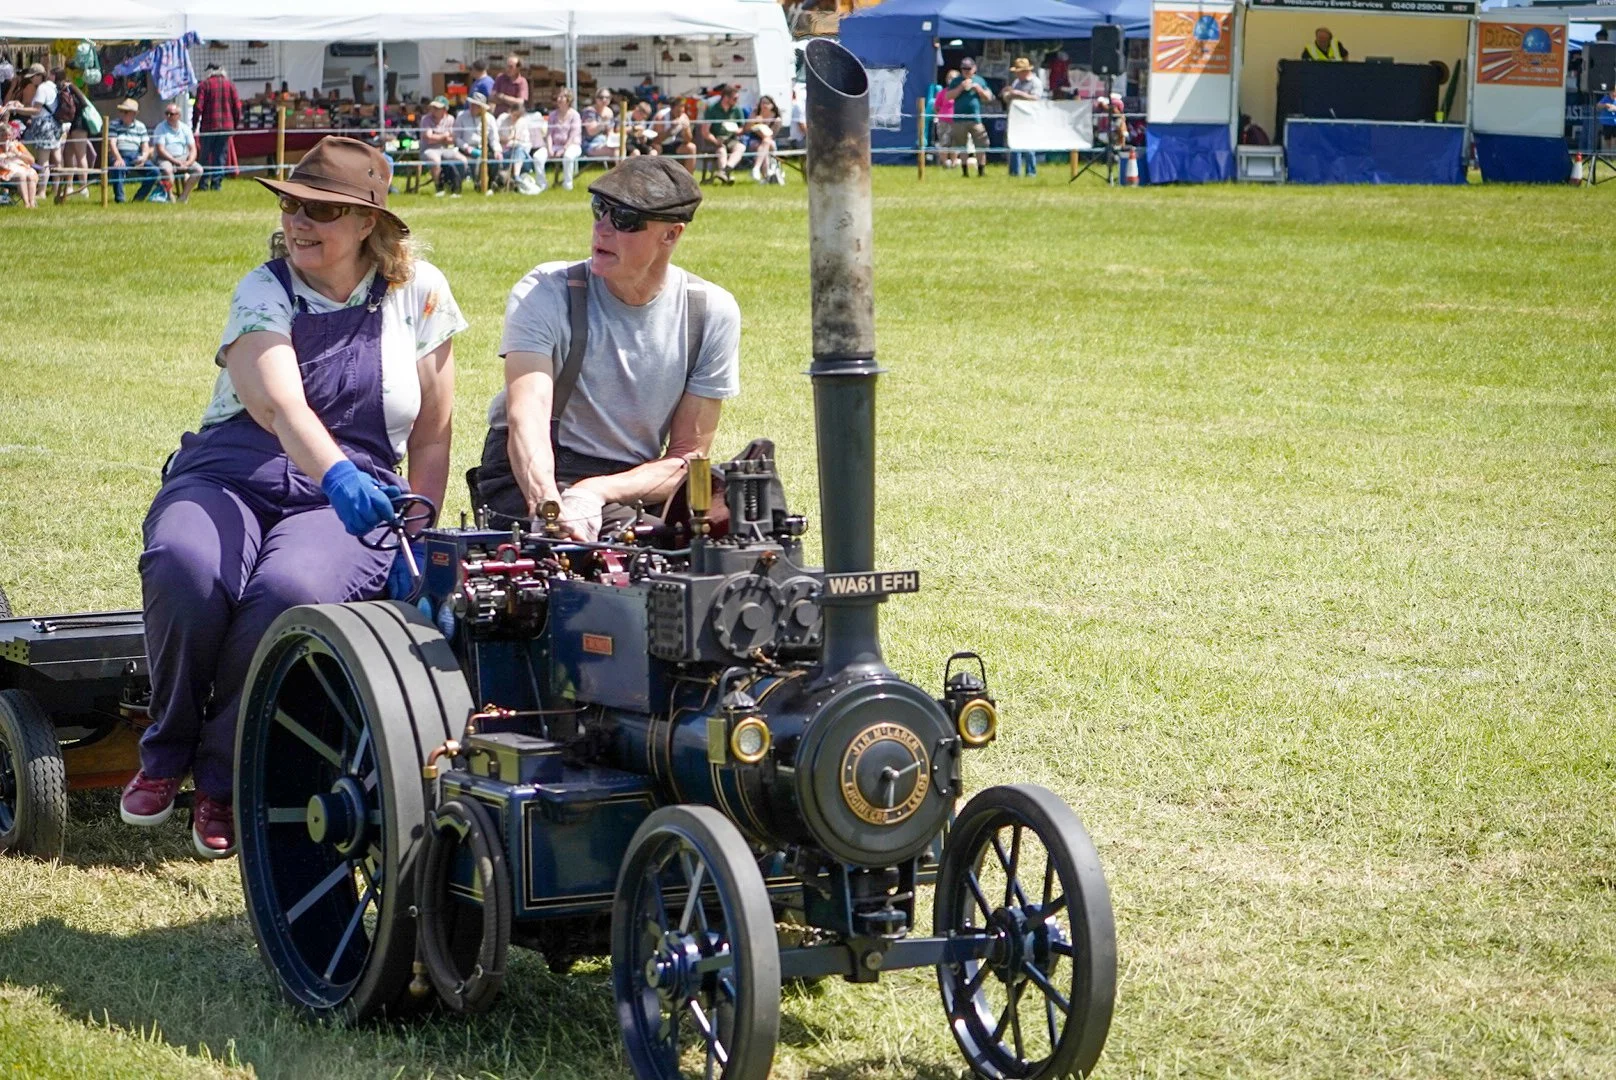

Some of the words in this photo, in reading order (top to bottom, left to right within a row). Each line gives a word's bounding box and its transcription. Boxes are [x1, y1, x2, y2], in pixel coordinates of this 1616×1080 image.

[1352, 0, 1384, 8] Services
[829, 576, 876, 594] WA61
[881, 573, 916, 592] EFH
[907, 774, 928, 810] LEEDS
